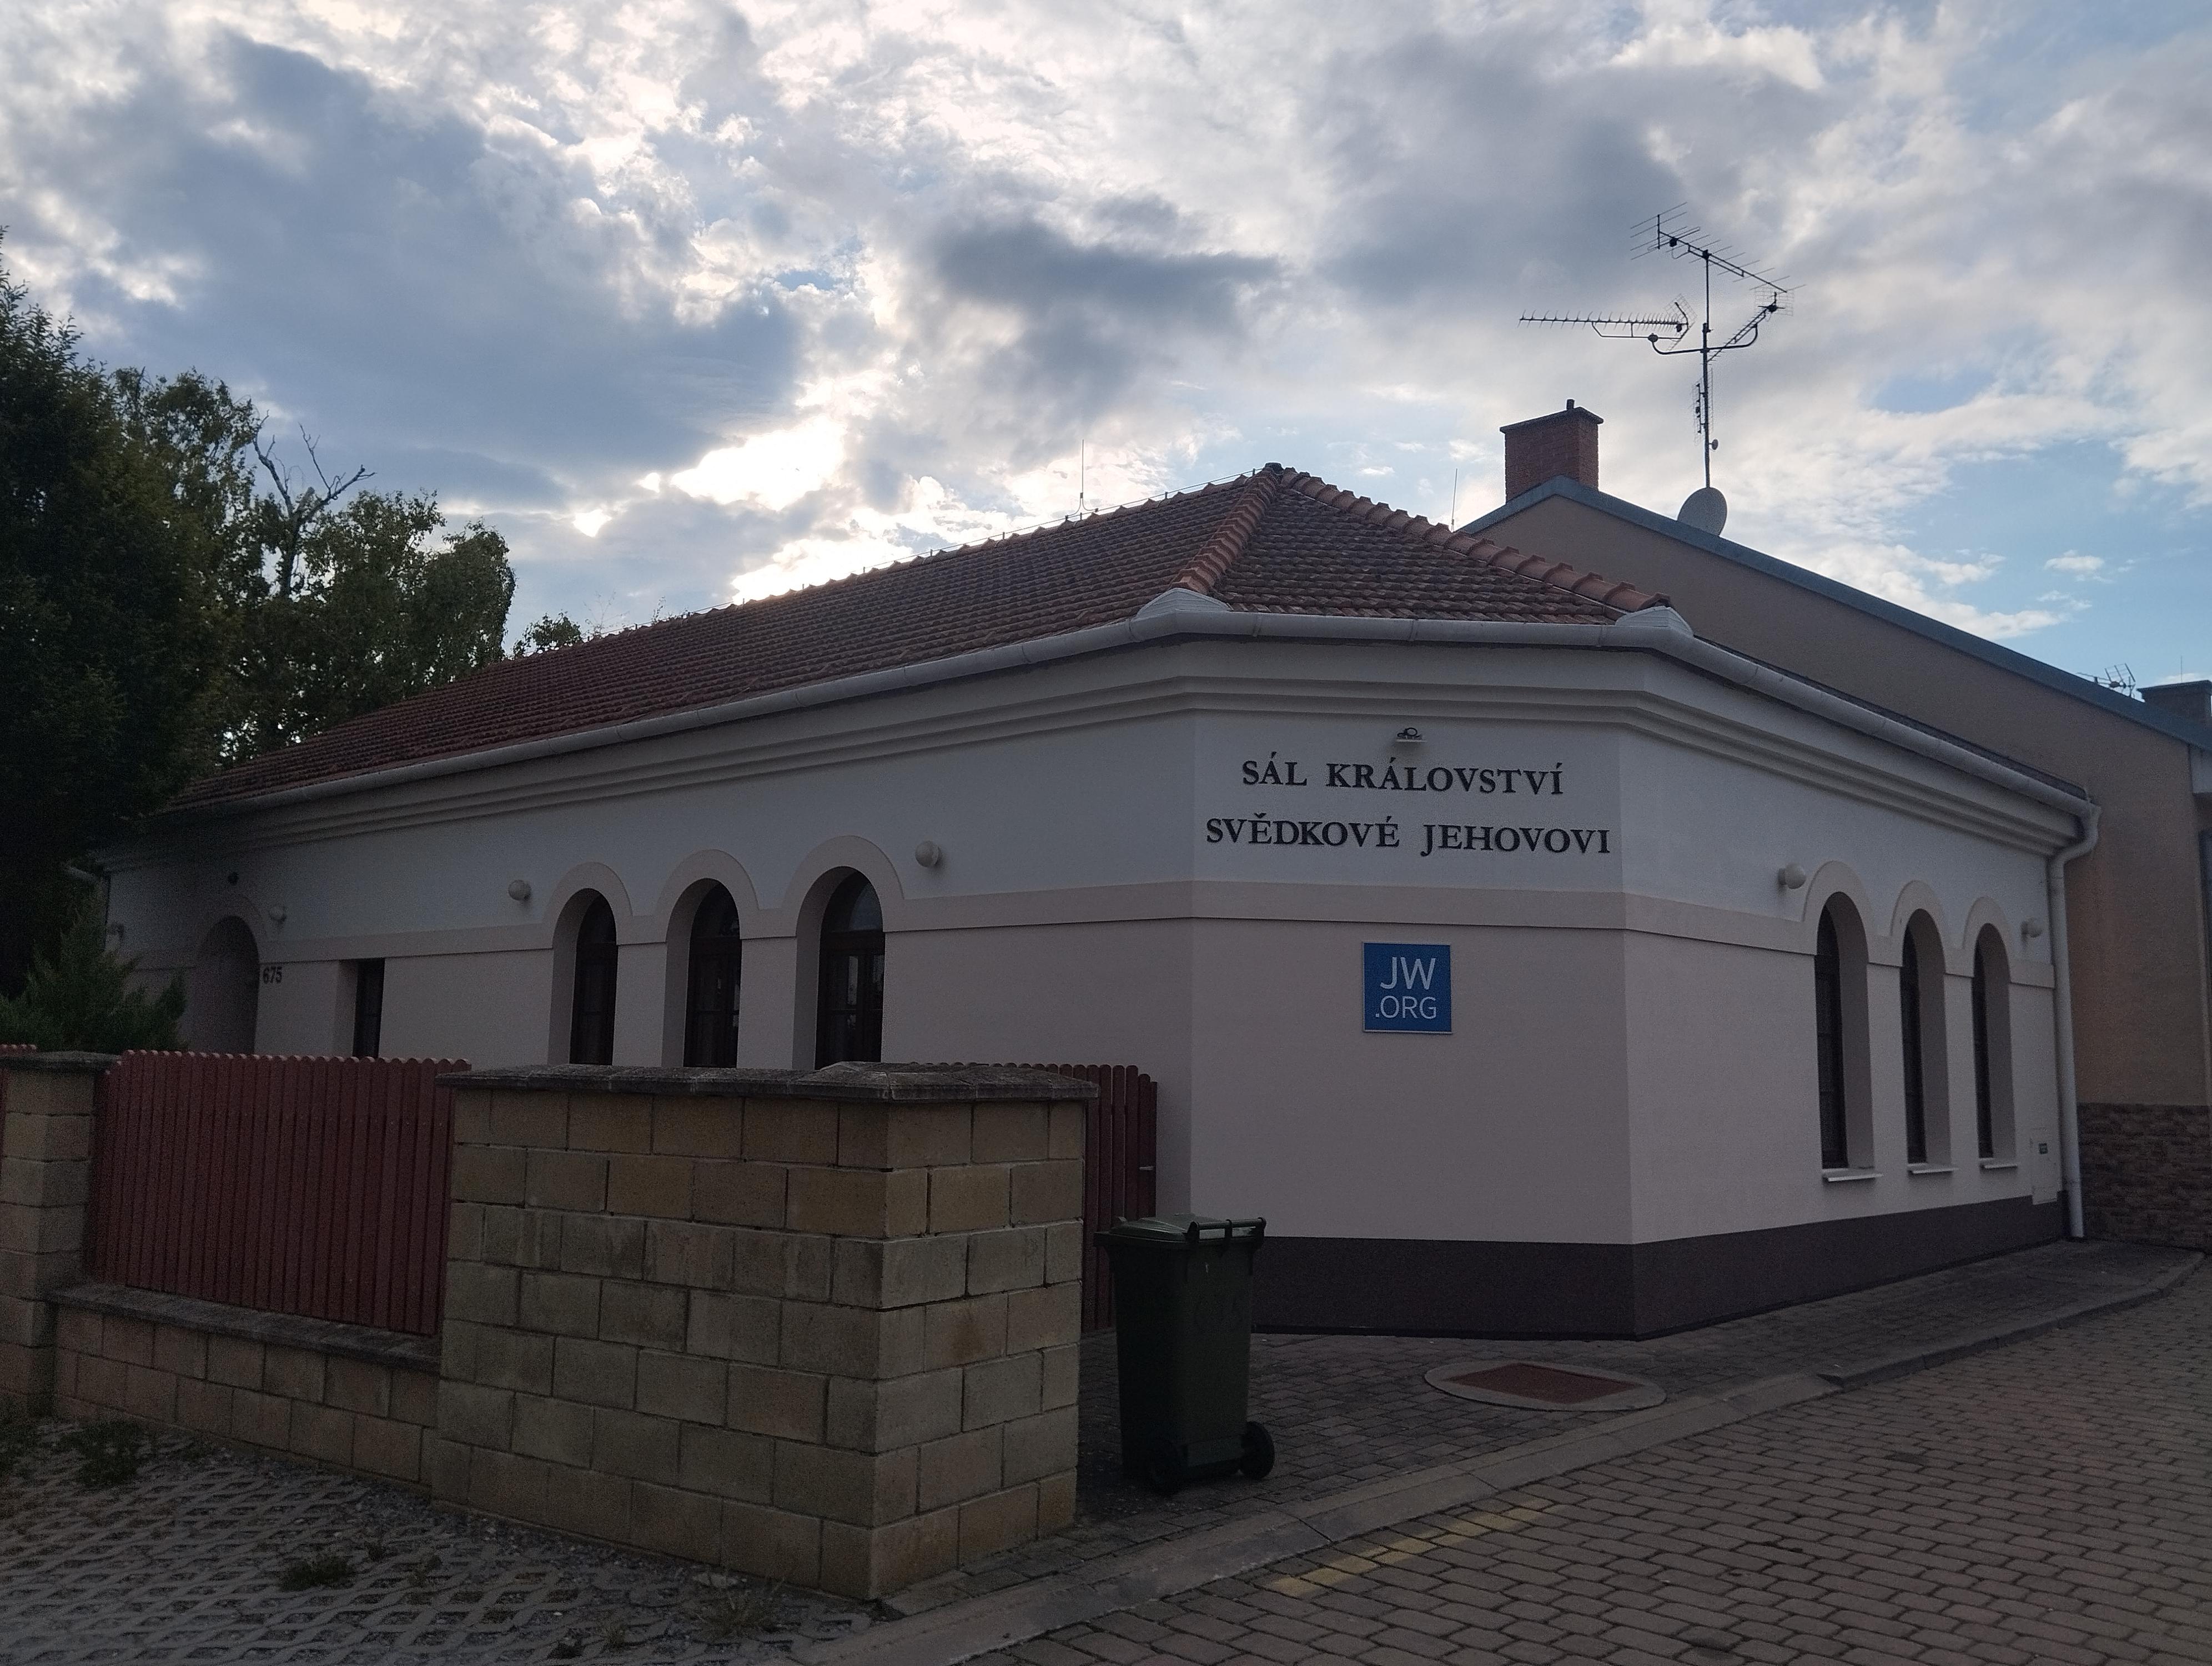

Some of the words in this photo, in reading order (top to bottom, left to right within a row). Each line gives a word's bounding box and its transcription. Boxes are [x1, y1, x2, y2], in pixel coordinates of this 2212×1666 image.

[1242, 752, 1308, 786] SÁL
[1326, 757, 1564, 795] KRÁLOVSTVÍ
[1206, 812, 1400, 849] SVĚDKOVÉ
[1420, 824, 1611, 857] JEHOVOVI
[263, 966, 283, 984] 675
[1380, 956, 1436, 990] JW
[1375, 995, 1437, 1020] .ORG
